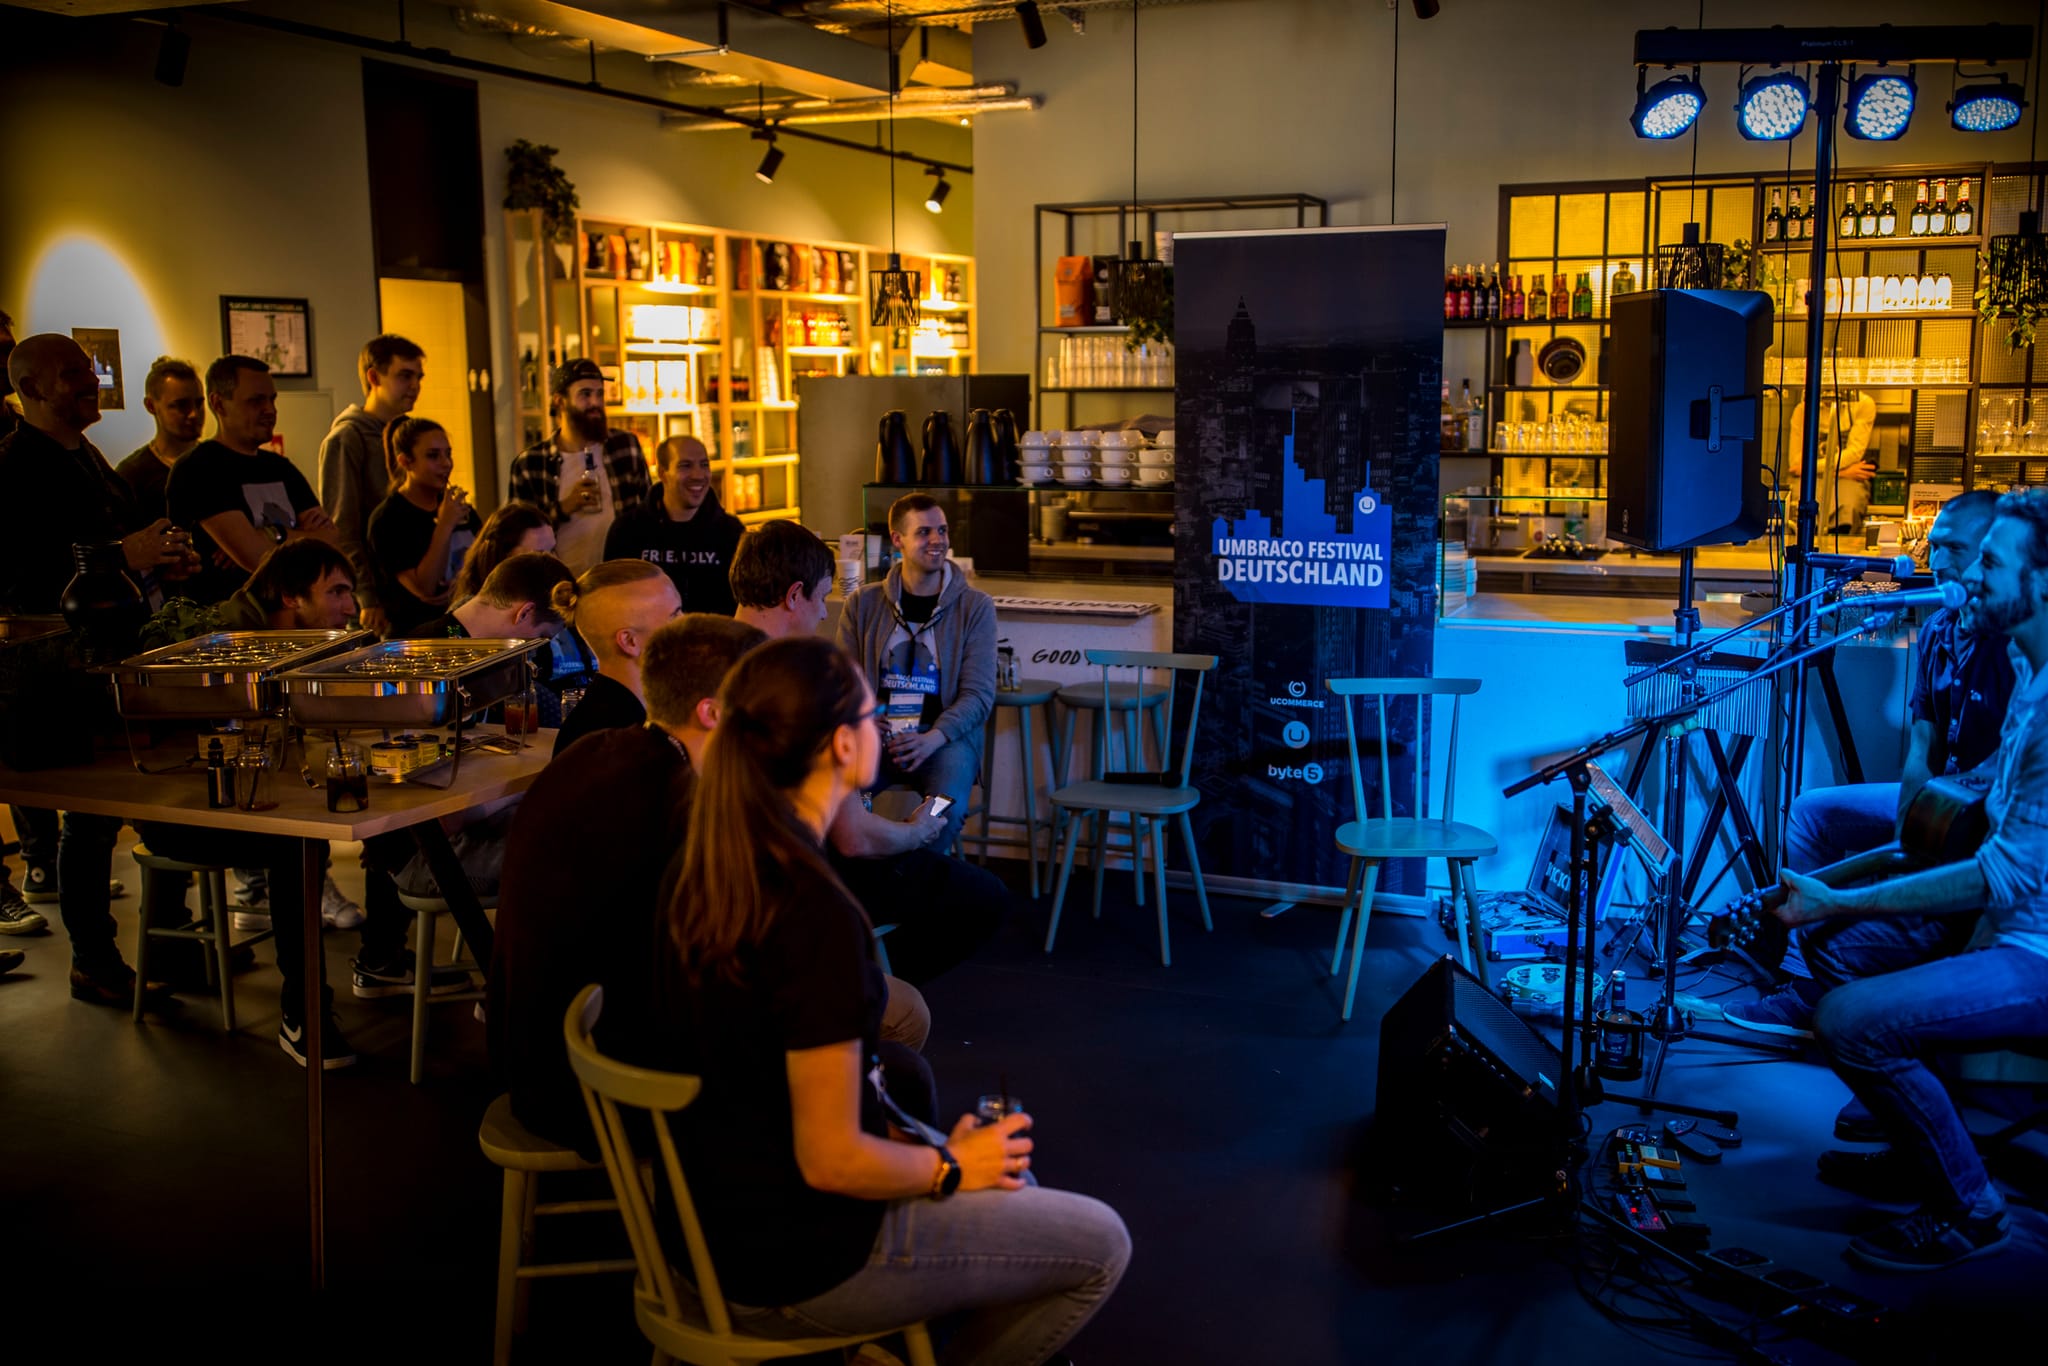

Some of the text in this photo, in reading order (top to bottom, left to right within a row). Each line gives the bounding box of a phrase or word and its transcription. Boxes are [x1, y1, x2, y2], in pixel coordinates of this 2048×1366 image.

[641, 548, 721, 566] FREDLY.
[1218, 538, 1384, 561] UMBRACO FESTIVAL
[1218, 558, 1384, 587] DEUTSCHLAND
[1032, 649, 1081, 665] GOOD
[1270, 697, 1325, 708] UCOMMERCE
[1267, 762, 1322, 782] byte5
